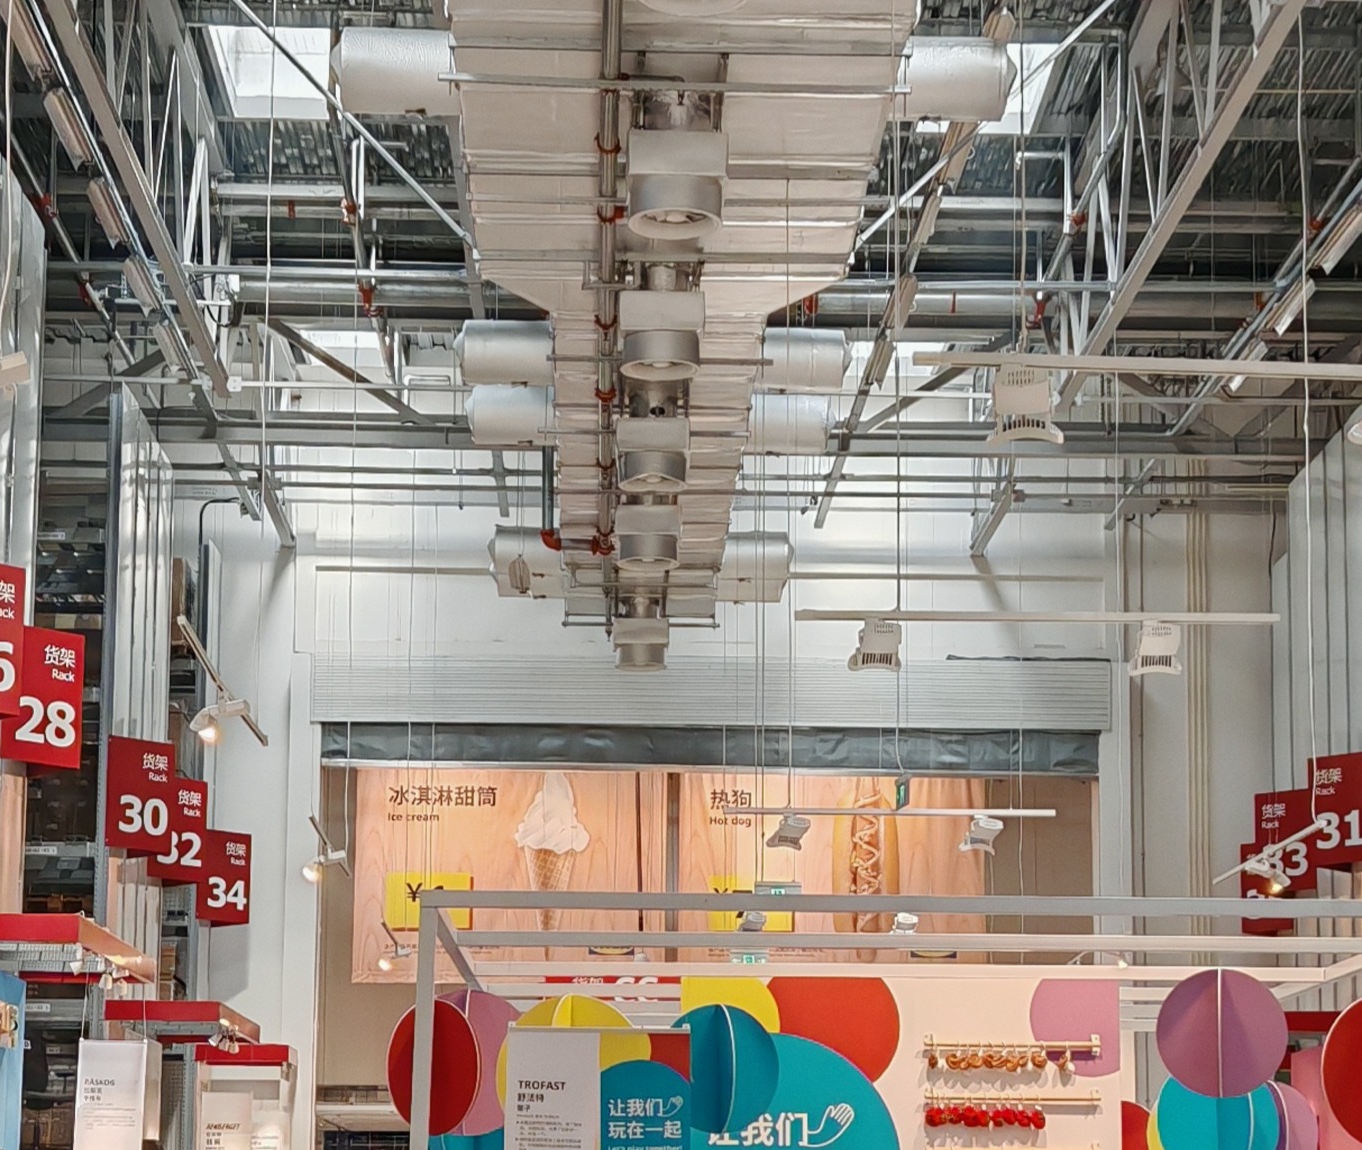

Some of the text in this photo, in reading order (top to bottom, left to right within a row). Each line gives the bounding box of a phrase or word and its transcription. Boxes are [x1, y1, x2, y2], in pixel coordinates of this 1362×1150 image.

[44, 644, 76, 668] 货架
[52, 668, 75, 682] Rack
[14, 696, 76, 748] 28
[142, 752, 169, 772] 货架
[148, 772, 168, 783] Rack
[1315, 767, 1343, 785] 货架
[178, 789, 202, 807] 货架
[388, 784, 498, 807] 冰淇淋甜筒
[710, 788, 753, 810] 热狗
[118, 794, 169, 836] 30
[183, 806, 201, 818] Rack
[388, 812, 440, 823] Ice cream
[1261, 803, 1286, 820] 货架
[709, 815, 752, 828] Hot dog
[226, 841, 246, 857] 货架
[230, 856, 246, 866] Rack
[206, 877, 248, 910] 34
[518, 1080, 567, 1091] TROFAST
[608, 1097, 664, 1118] 让我们
[608, 1121, 682, 1139] 玩在一起
